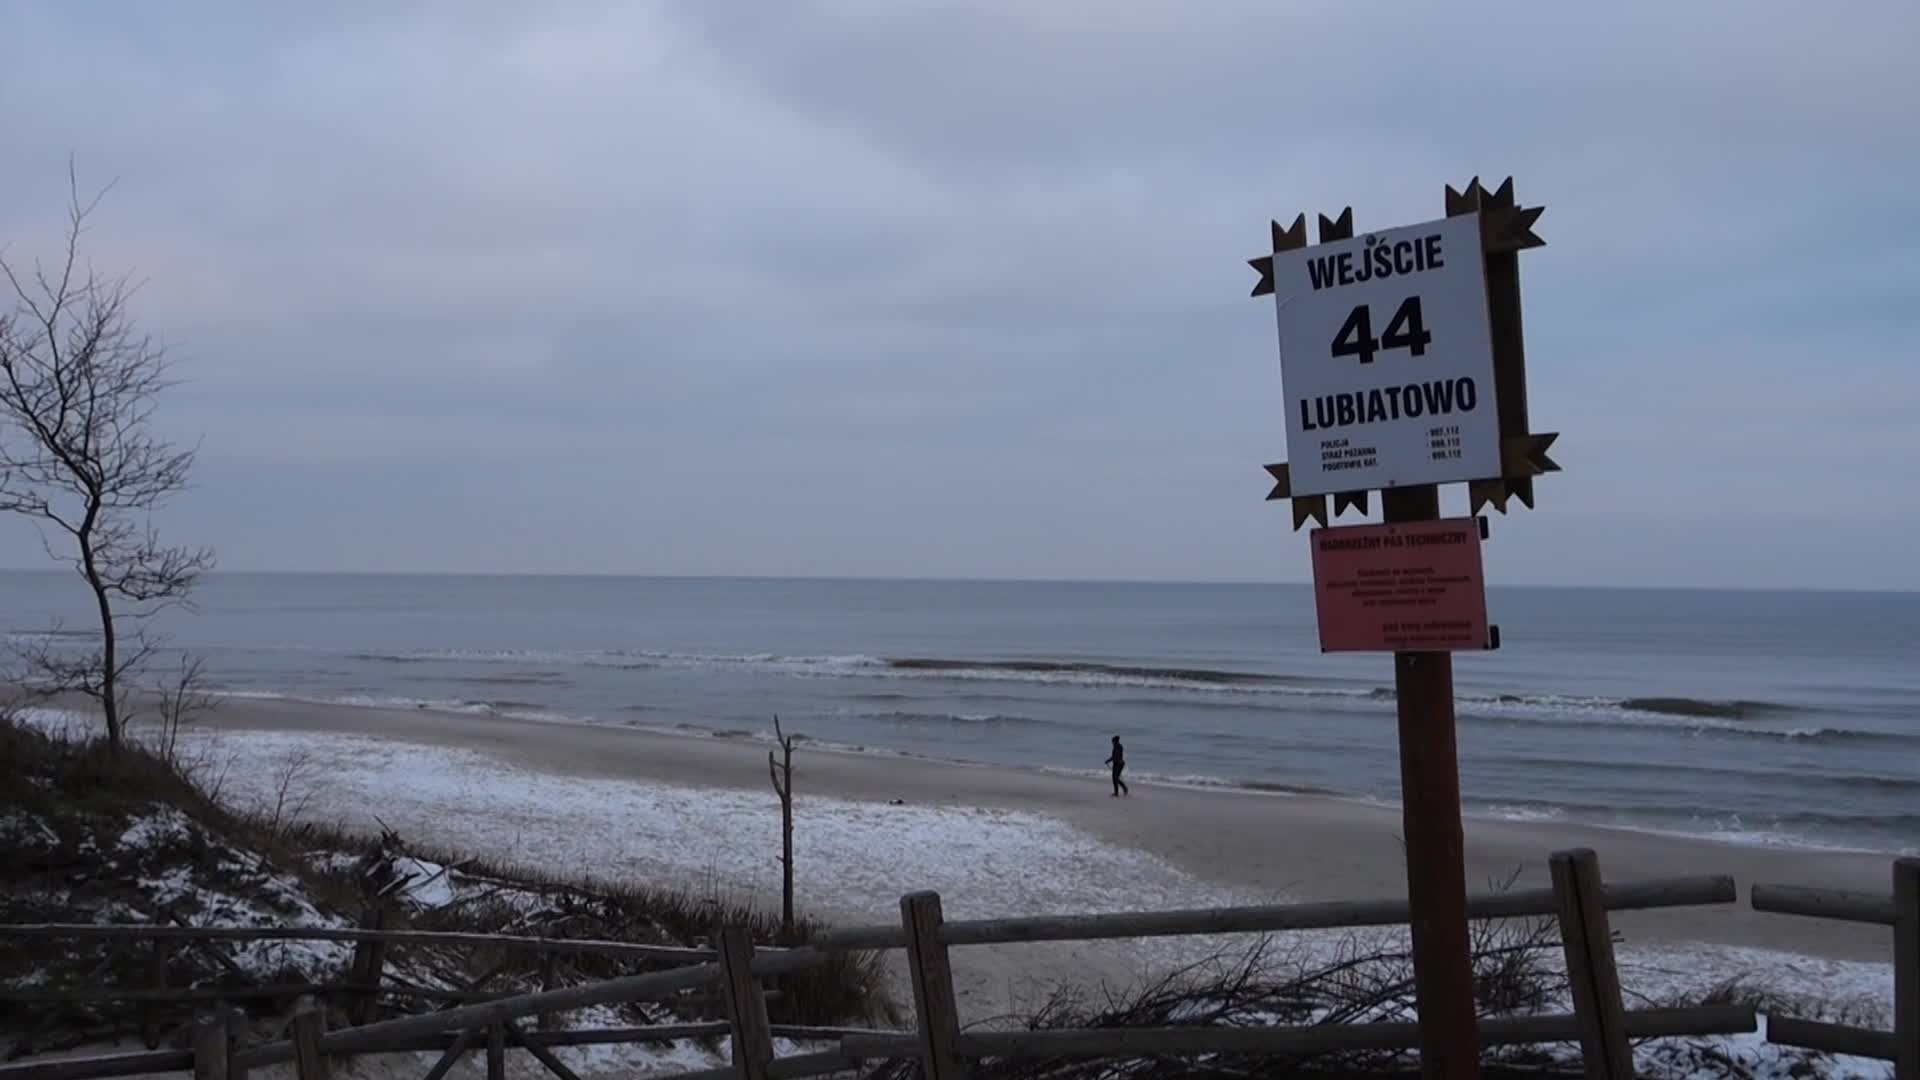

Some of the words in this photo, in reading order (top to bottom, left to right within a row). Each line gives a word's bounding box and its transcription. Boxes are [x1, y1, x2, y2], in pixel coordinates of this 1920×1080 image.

[1307, 234, 1444, 290] WEJŚCIE
[1330, 295, 1431, 365] 44
[1300, 376, 1477, 432] LUBIATOWO
